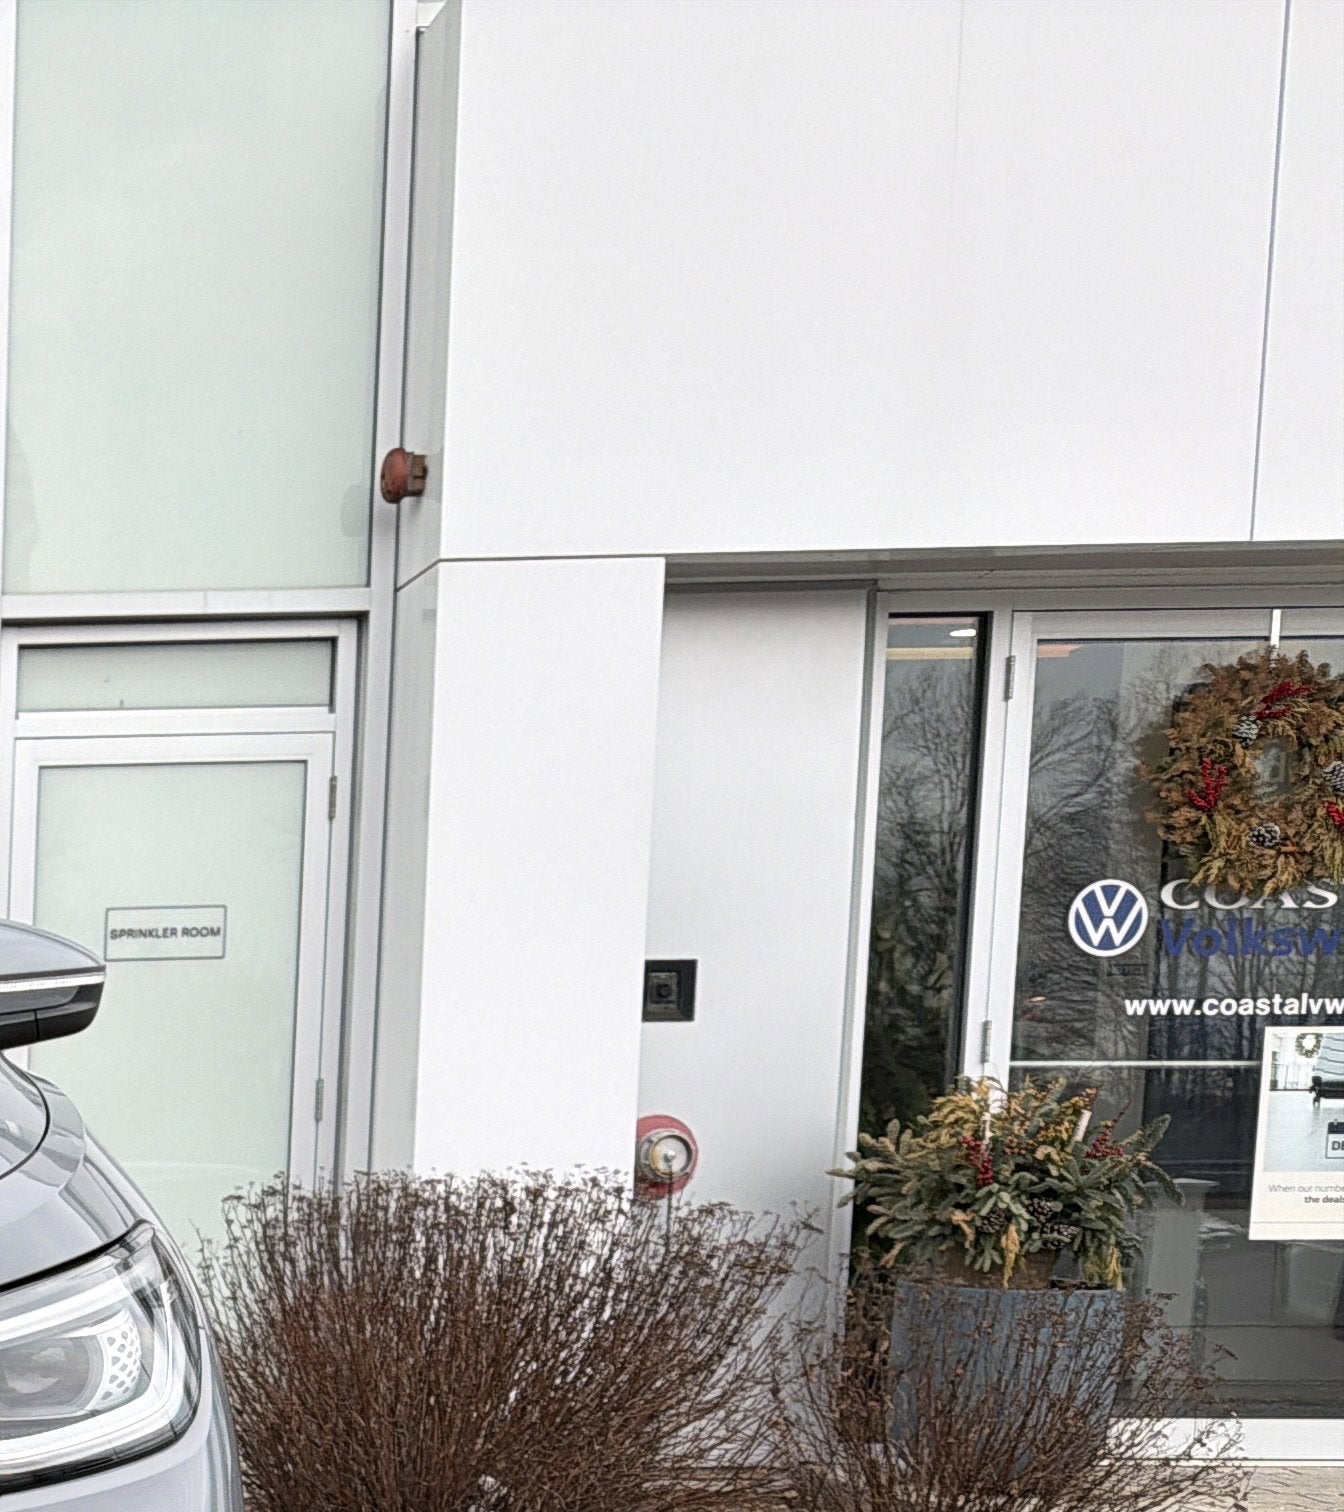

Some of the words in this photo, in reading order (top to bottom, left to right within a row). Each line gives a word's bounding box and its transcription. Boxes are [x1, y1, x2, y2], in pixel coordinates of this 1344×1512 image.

[109, 927, 178, 940] SPRINKLER
[181, 926, 221, 938] ROOM
[1160, 915, 1341, 957] Volksw
[1124, 992, 1344, 1016] www.coastalvw
[1304, 1195, 1320, 1203] the
